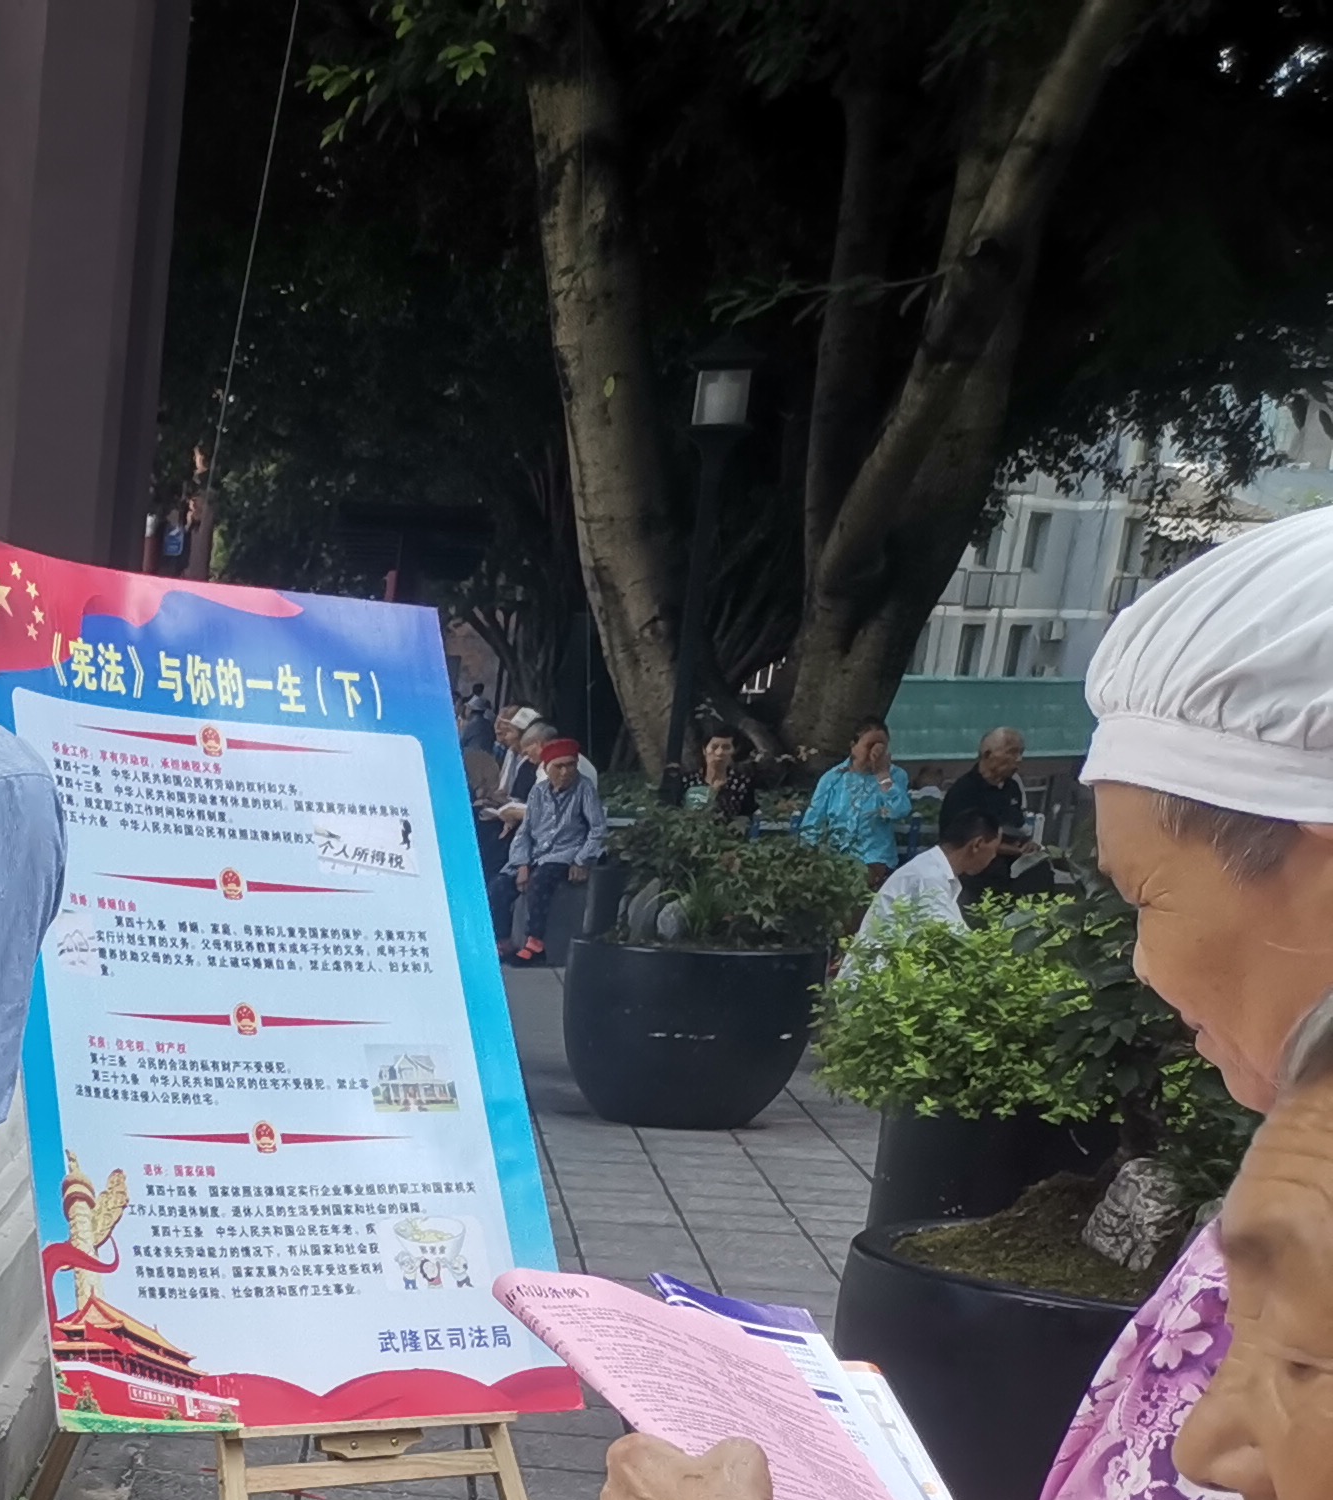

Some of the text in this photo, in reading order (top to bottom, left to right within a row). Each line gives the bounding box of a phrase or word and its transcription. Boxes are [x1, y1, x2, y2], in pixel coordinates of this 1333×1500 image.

[53, 757, 101, 778] 第四十二条
[55, 774, 103, 794] 第四十三条
[318, 840, 406, 870] 个人所得税
[114, 914, 167, 932] 第四十九条
[90, 1052, 291, 1074] 第十三条 公民的合法的私有财产不受侵犯。
[91, 1069, 369, 1091] 第三十九条 中华人民共和国公民的住宅不受侵犯。禁止非
[146, 1181, 477, 1198] 第四十四条 国家依照法律规定实行企业事业组织的职工和国家机关
[128, 1202, 427, 1218] 工作人员的退休制度。退休人员的生活受到国家和社会的保障。
[151, 1223, 377, 1238] 第四十五条 中华人民共和国公民在年老、疾
[132, 1242, 381, 1258] 病或者丧失劳动能力的情况下，有从国家和社会获
[135, 1262, 383, 1279] 得物质帮助的权利。国家发展为公民享受这些权利
[137, 1283, 361, 1300] 所需要的社会保险、社会救济和医疗卫生事业。
[377, 1324, 512, 1353] 武隆区司法局
